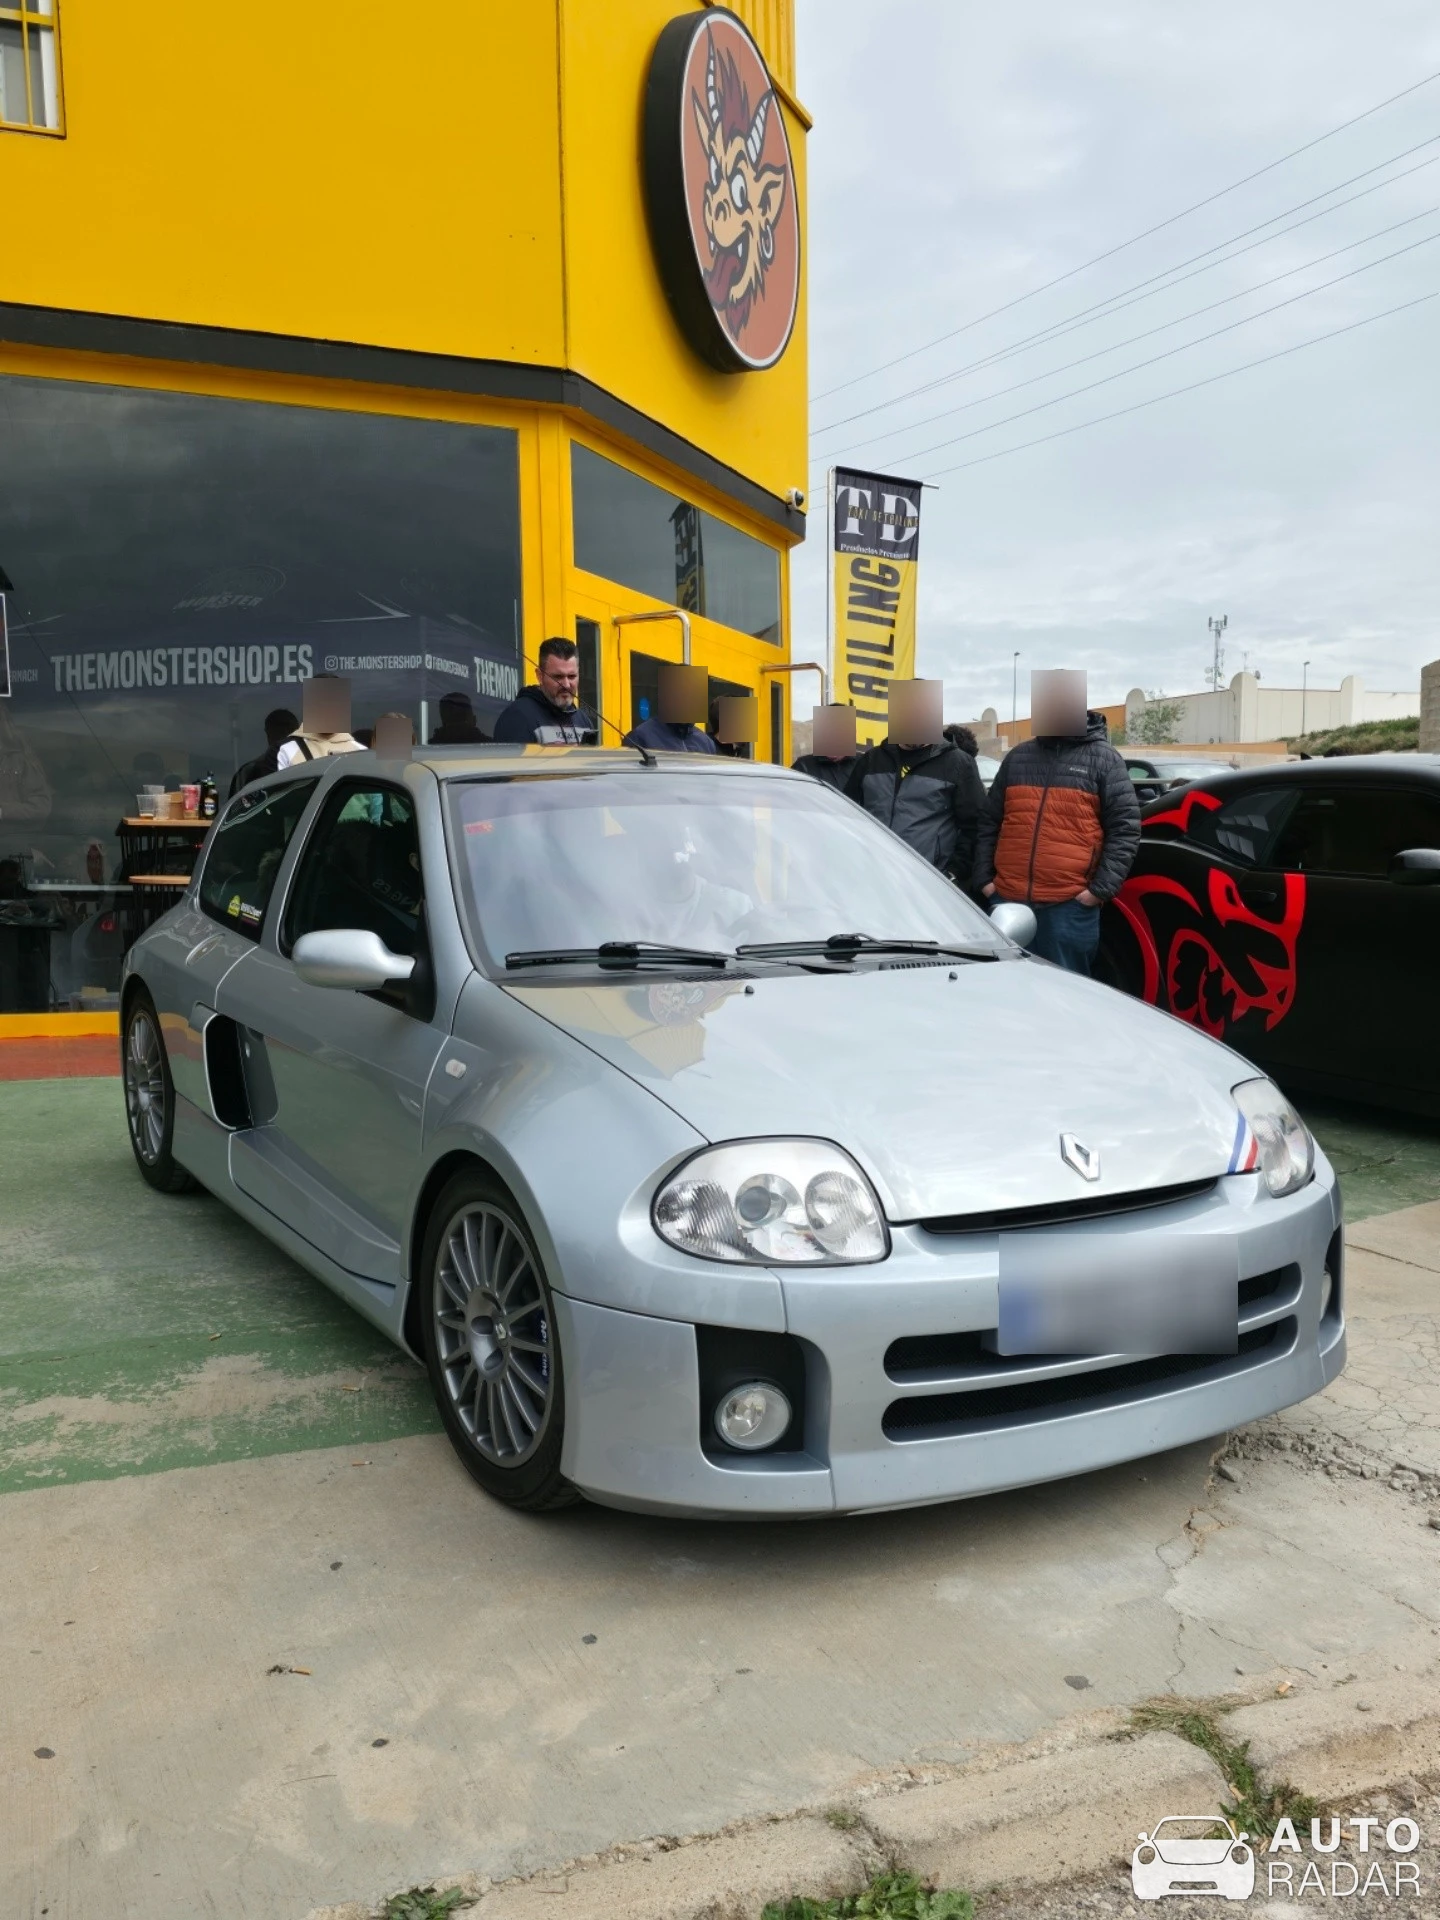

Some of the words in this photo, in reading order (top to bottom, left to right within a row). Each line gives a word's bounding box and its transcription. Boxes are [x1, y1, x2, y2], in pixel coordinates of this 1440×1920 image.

[50, 644, 314, 692] THEMONSTERSHOP.ES
[339, 654, 423, 670] THE.MONSTERSHOP
[846, 557, 900, 752] TAILING
